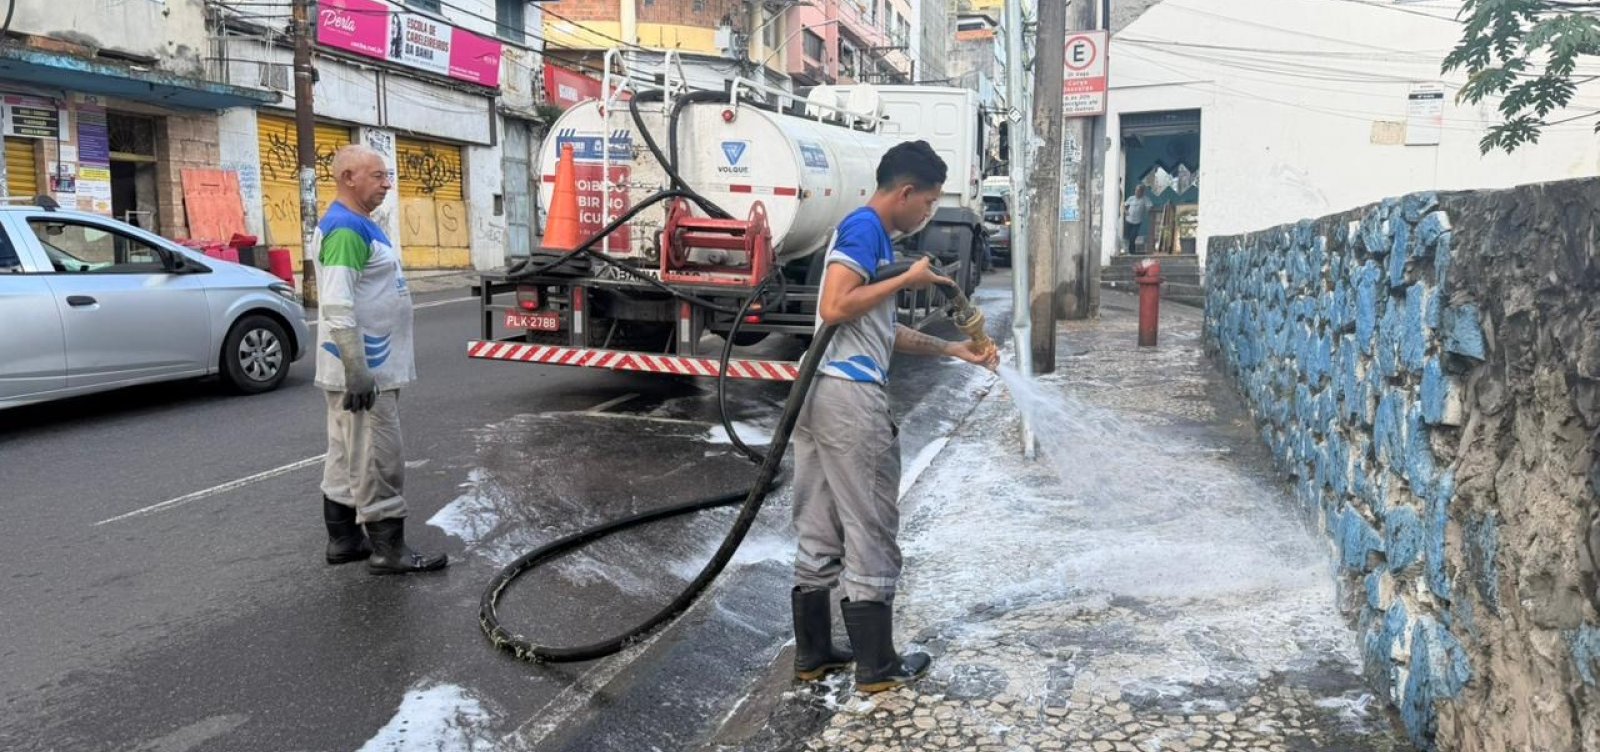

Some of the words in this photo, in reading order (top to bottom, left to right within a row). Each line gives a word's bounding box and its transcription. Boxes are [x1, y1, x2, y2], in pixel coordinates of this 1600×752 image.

[407, 17, 428, 33] ESCOLA
[430, 24, 436, 36] DE
[405, 43, 414, 55] DA
[415, 45, 434, 60] BAHIA
[1074, 44, 1085, 62] E
[578, 195, 600, 208] BIR
